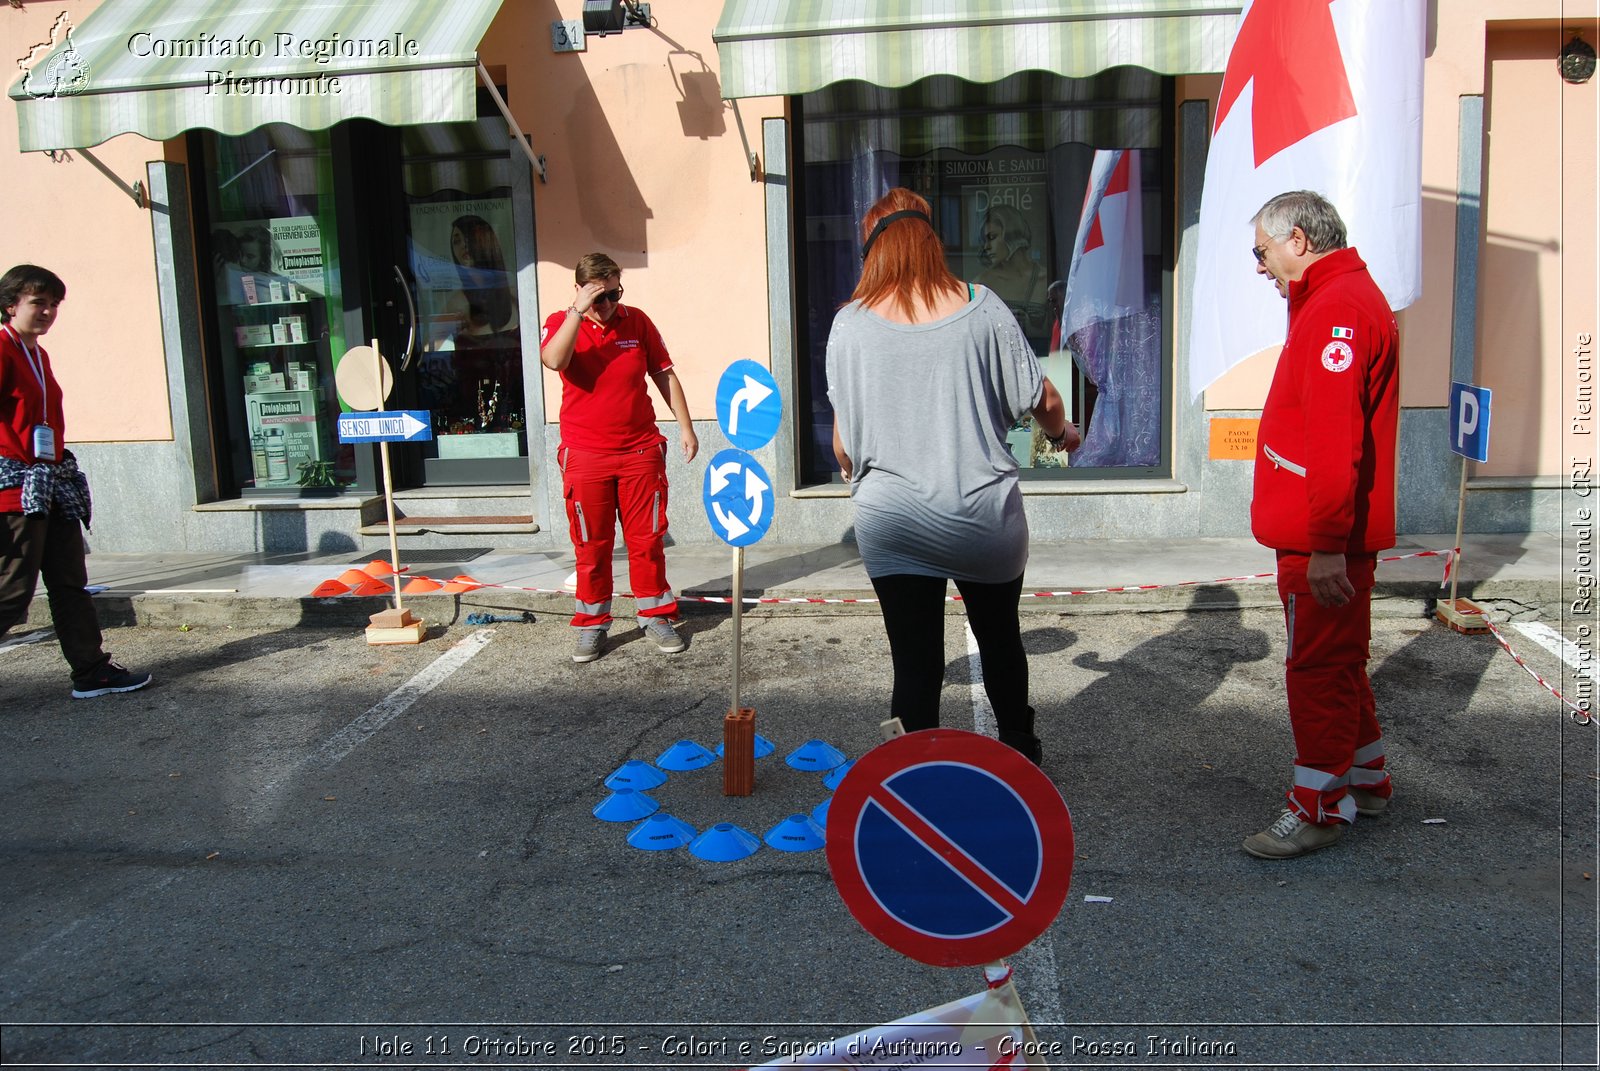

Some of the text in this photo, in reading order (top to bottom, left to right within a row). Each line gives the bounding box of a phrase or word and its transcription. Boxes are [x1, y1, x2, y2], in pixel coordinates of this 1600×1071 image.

[558, 26, 579, 45] 31
[945, 161, 994, 175] SIMONA
[999, 160, 1006, 172] E
[341, 419, 405, 436] SENSO UNICO
[1458, 390, 1479, 448] P
